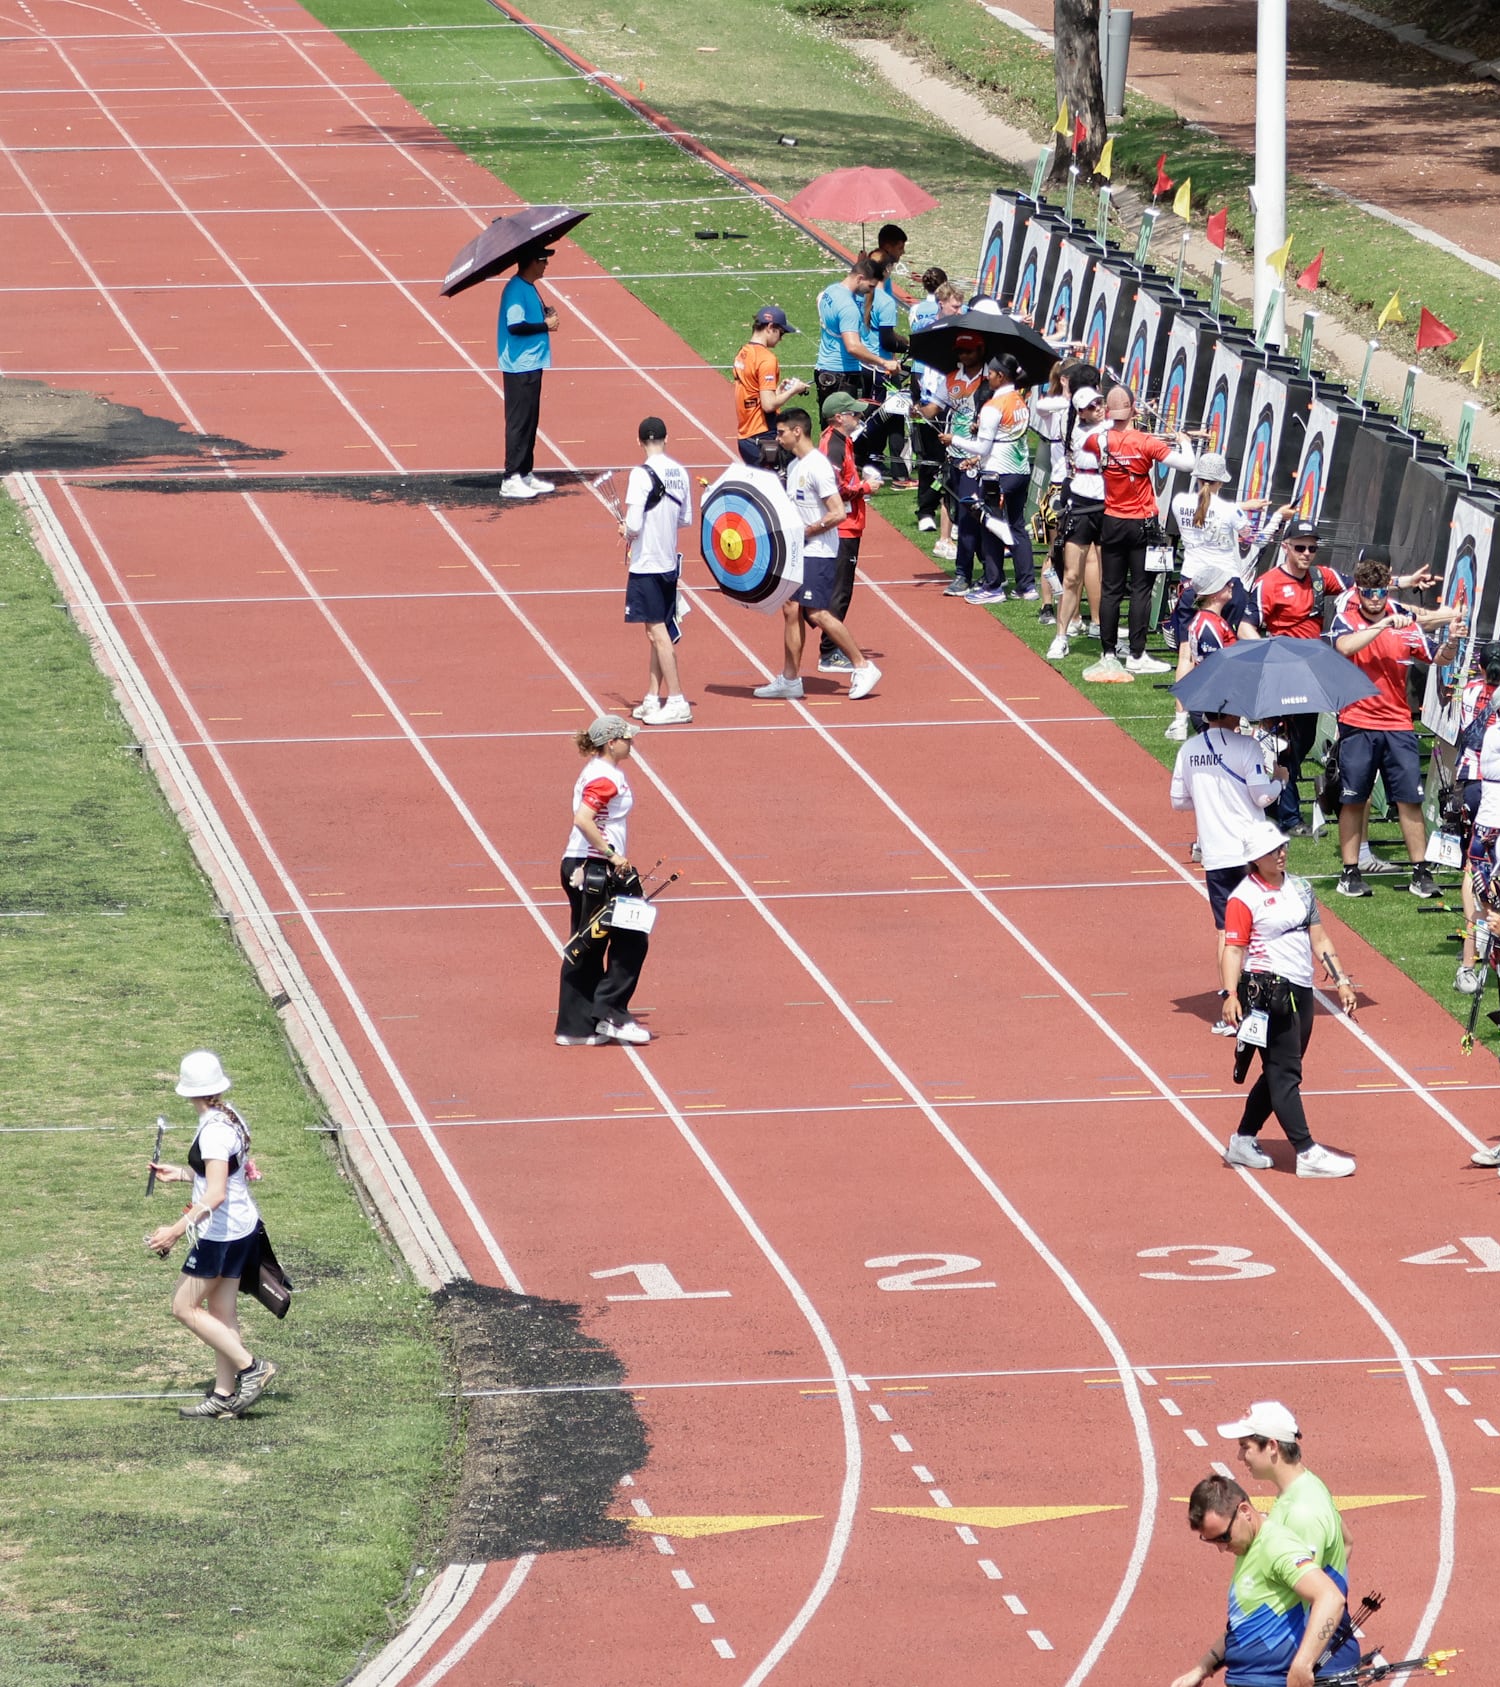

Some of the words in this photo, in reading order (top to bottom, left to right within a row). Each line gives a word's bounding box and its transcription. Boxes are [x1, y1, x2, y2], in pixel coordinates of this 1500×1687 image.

[1457, 418, 1471, 464] 43
[1281, 695, 1308, 705] INESIS
[1189, 753, 1224, 768] FRANCE
[629, 909, 641, 920] 11
[863, 1252, 998, 1291] 2
[1136, 1244, 1276, 1281] 3
[589, 1262, 732, 1302] 1
